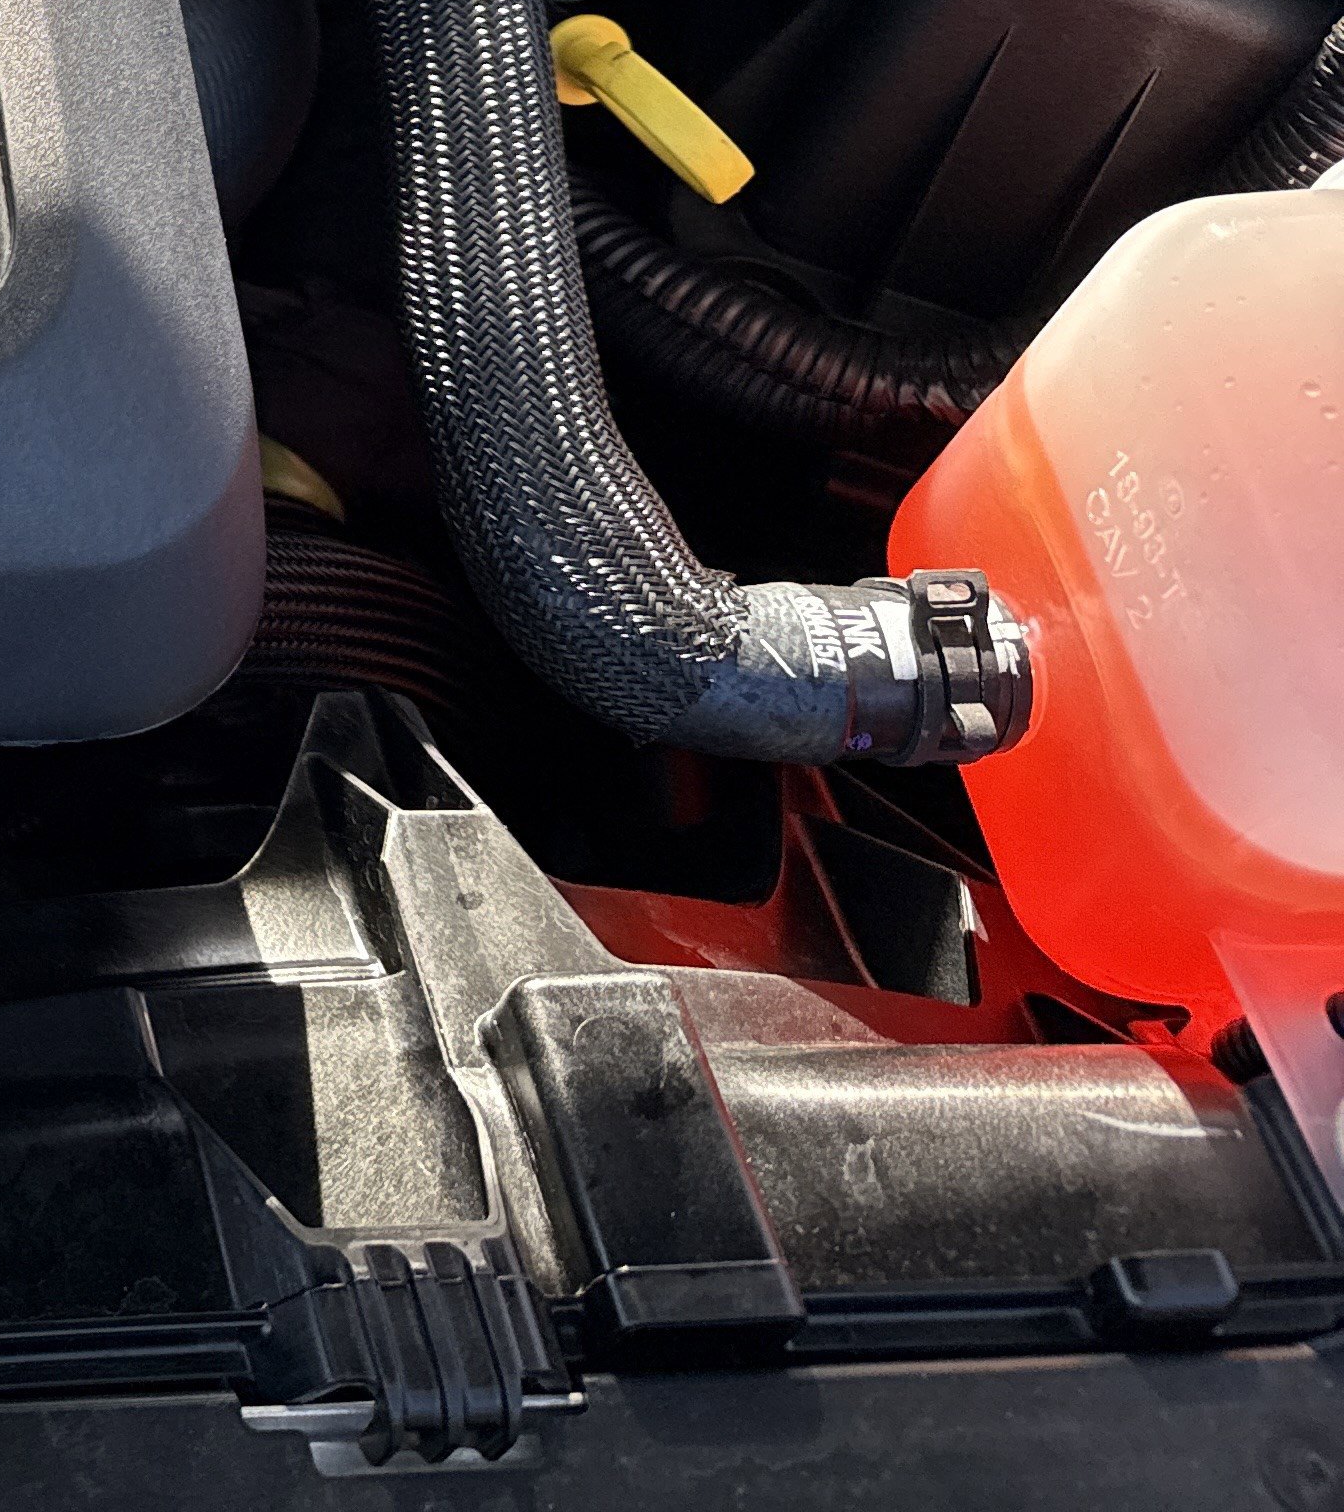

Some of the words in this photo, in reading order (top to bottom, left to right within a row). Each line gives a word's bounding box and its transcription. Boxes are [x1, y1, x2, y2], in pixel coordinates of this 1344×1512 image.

[1086, 487, 1140, 578] CAV
[1125, 594, 1153, 630] 2
[833, 605, 886, 660] TNK
